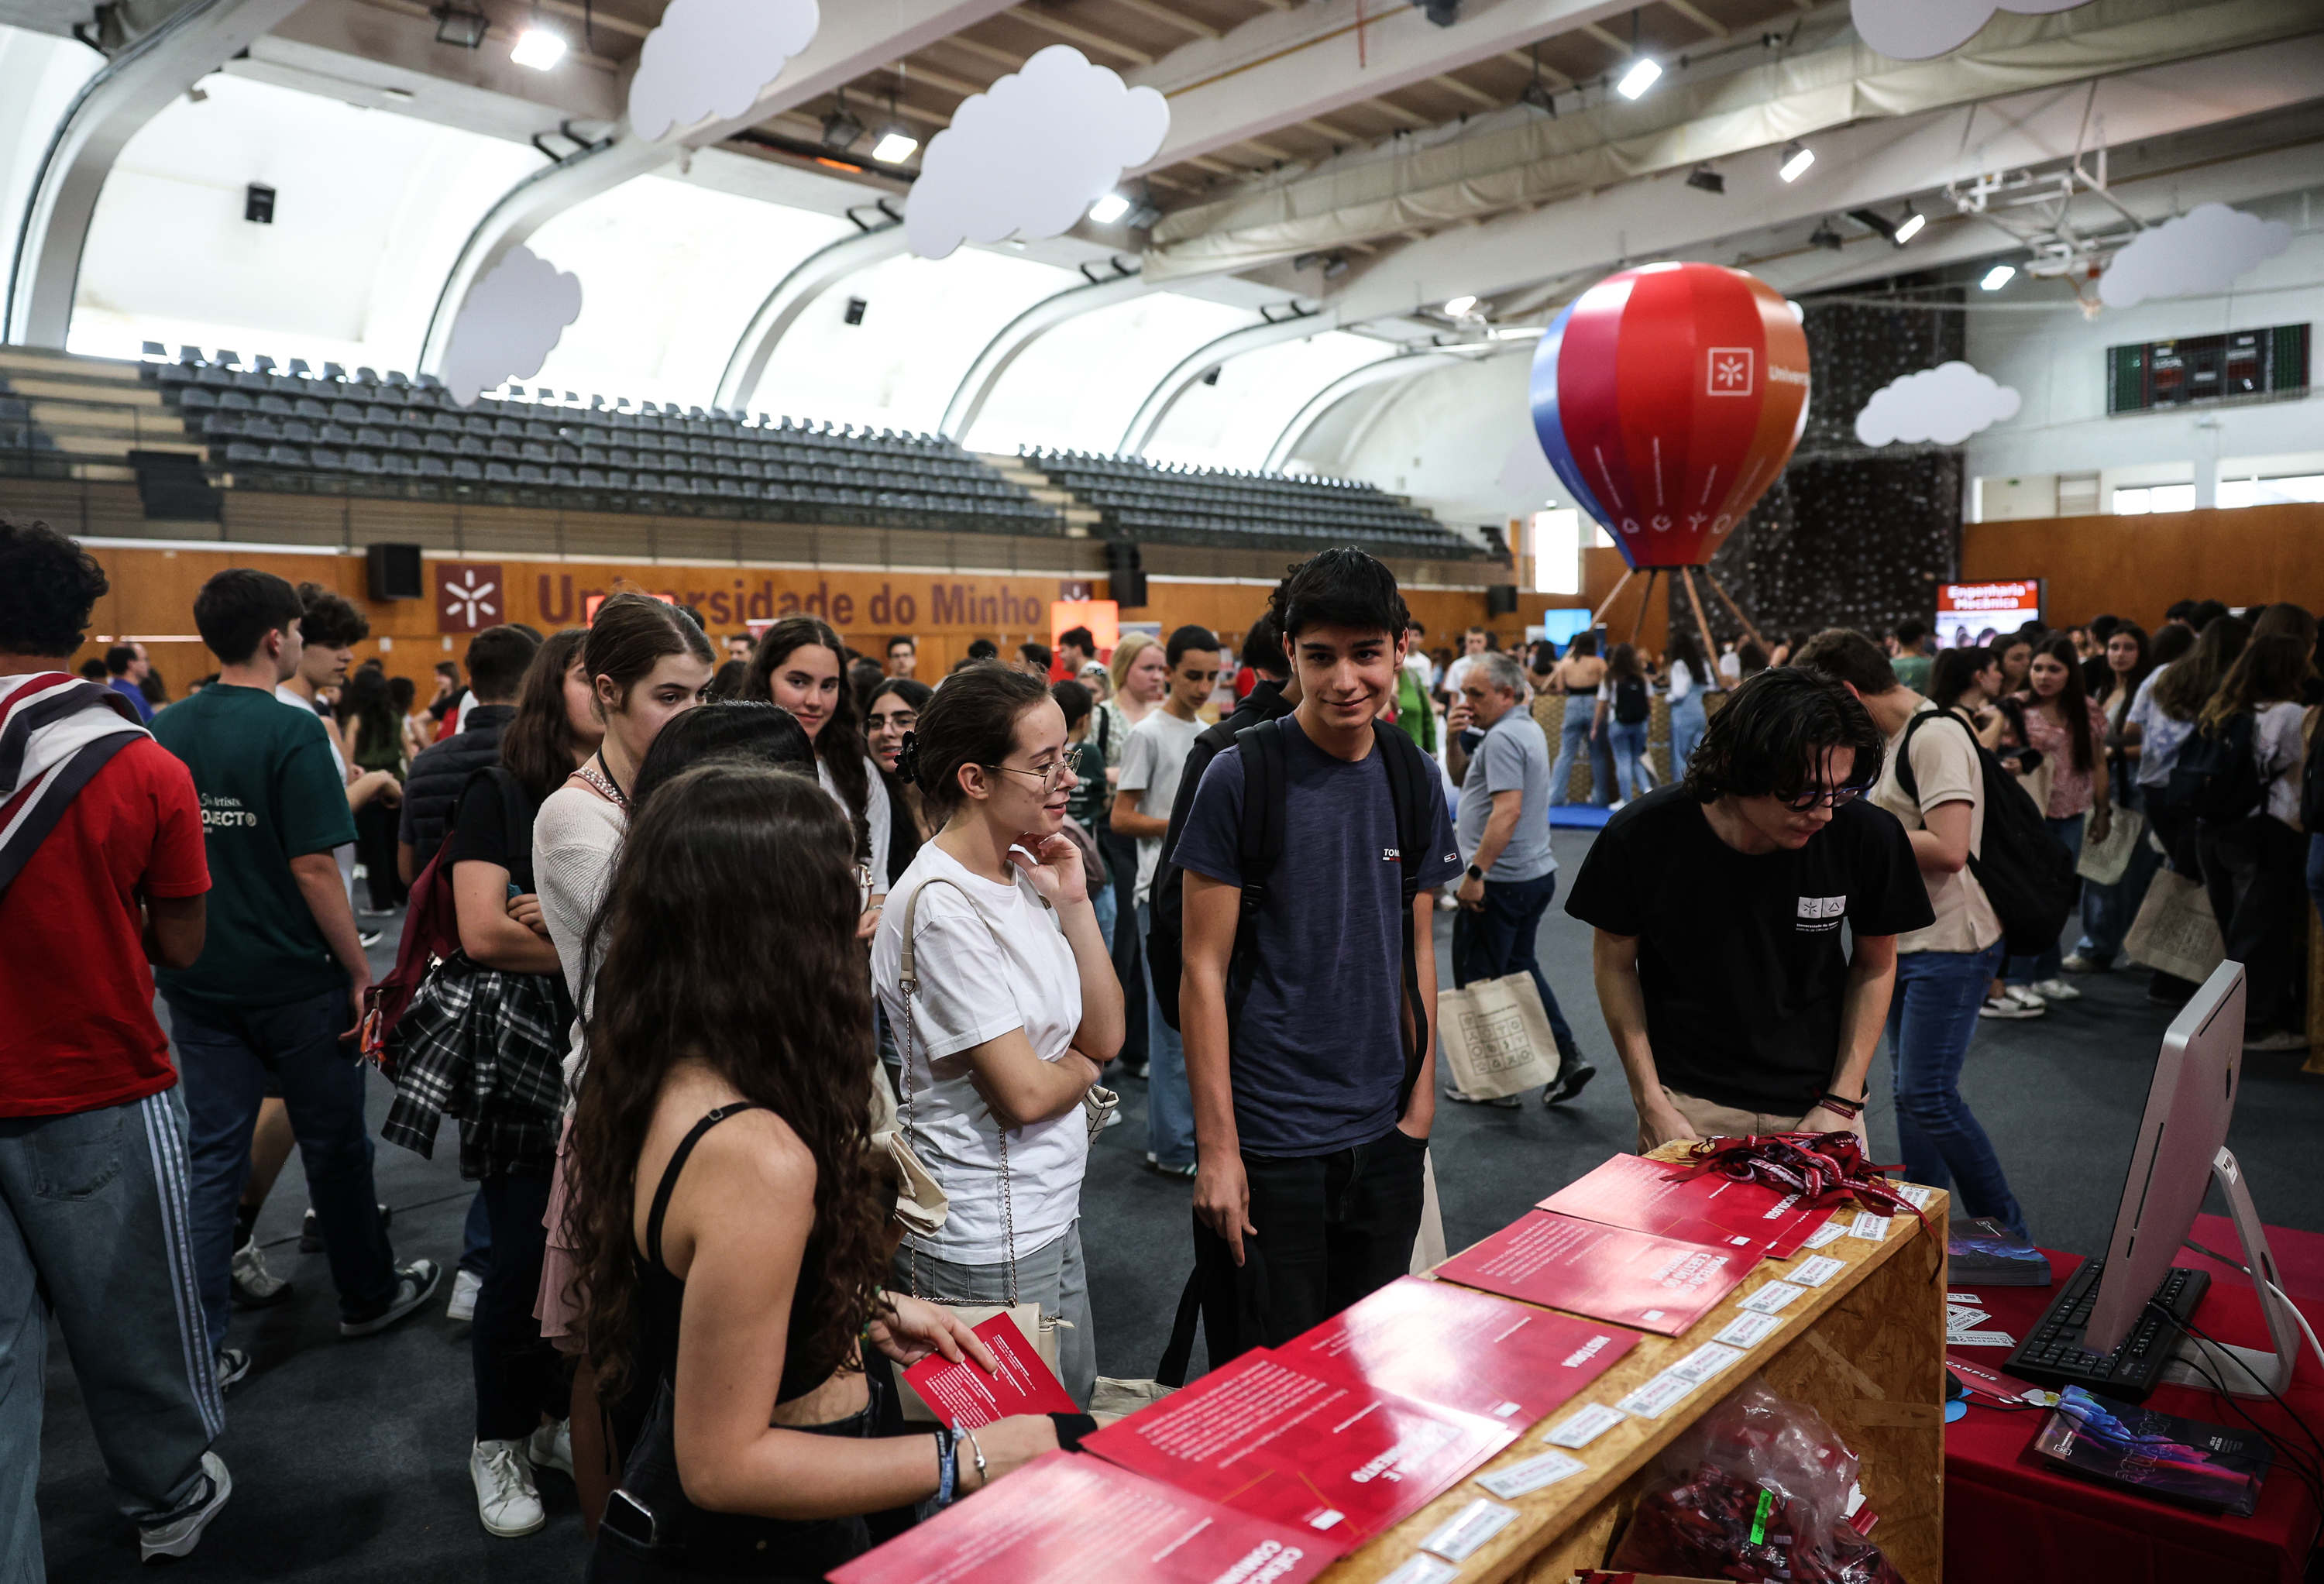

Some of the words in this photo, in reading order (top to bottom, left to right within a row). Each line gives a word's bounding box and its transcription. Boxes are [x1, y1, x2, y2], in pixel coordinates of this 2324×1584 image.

[869, 583, 916, 625] do
[931, 584, 1043, 626] Minho
[1948, 583, 2027, 600] Engenharia
[1953, 597, 2019, 610] Mecânica
[1762, 1194, 1802, 1220] SOCIOLOGIA
[1673, 1257, 1706, 1280] GESTÃO
[1689, 1256, 1730, 1284] PROTEÇÃO
[985, 1342, 995, 1355] LOCAL
[999, 1361, 1026, 1397] FUNCIONAMENTO
[1945, 1360, 1998, 1381] CAMPUS
[970, 1373, 995, 1403] PROFISSIONAIS
